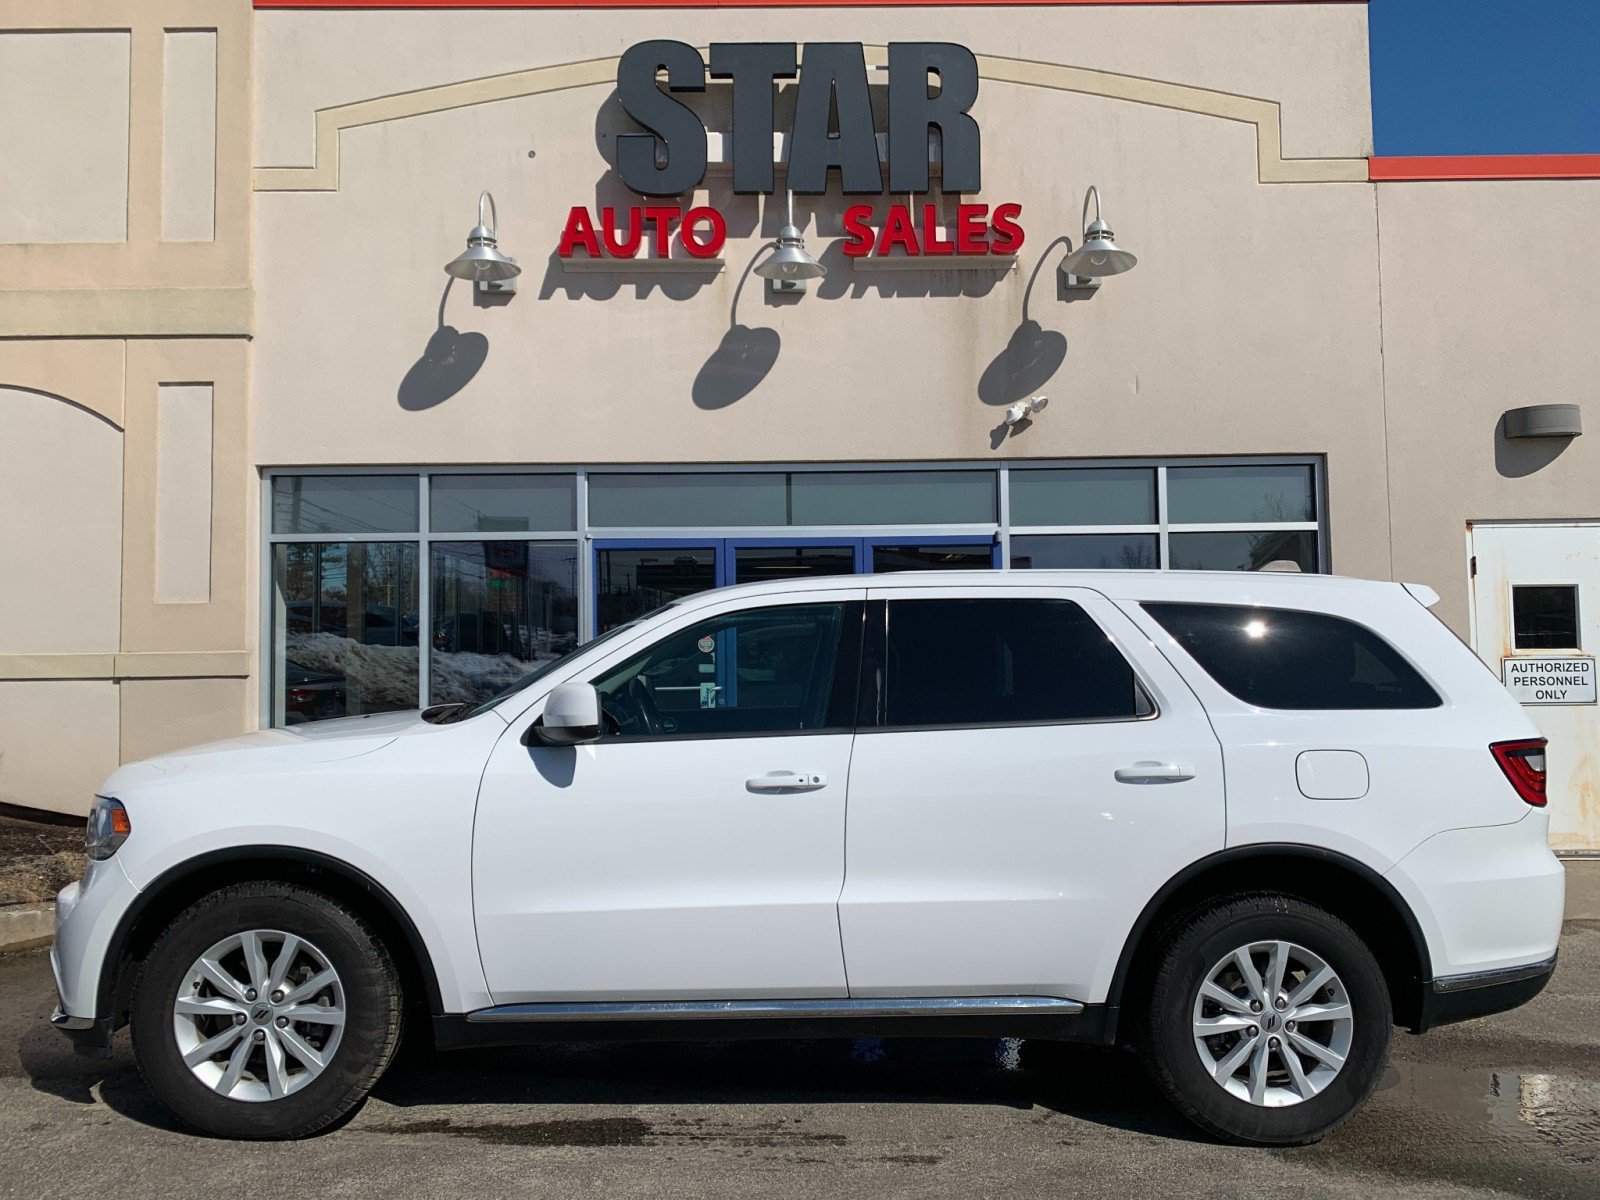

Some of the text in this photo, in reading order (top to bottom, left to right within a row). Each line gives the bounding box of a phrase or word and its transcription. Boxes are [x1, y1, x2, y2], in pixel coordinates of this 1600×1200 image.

[616, 39, 981, 196] STAR
[558, 203, 1025, 259] AUTO SALES
[1510, 662, 1590, 673] AUTHORIZED
[1513, 676, 1589, 686] PERSONNEL
[1535, 689, 1568, 700] ONLY
